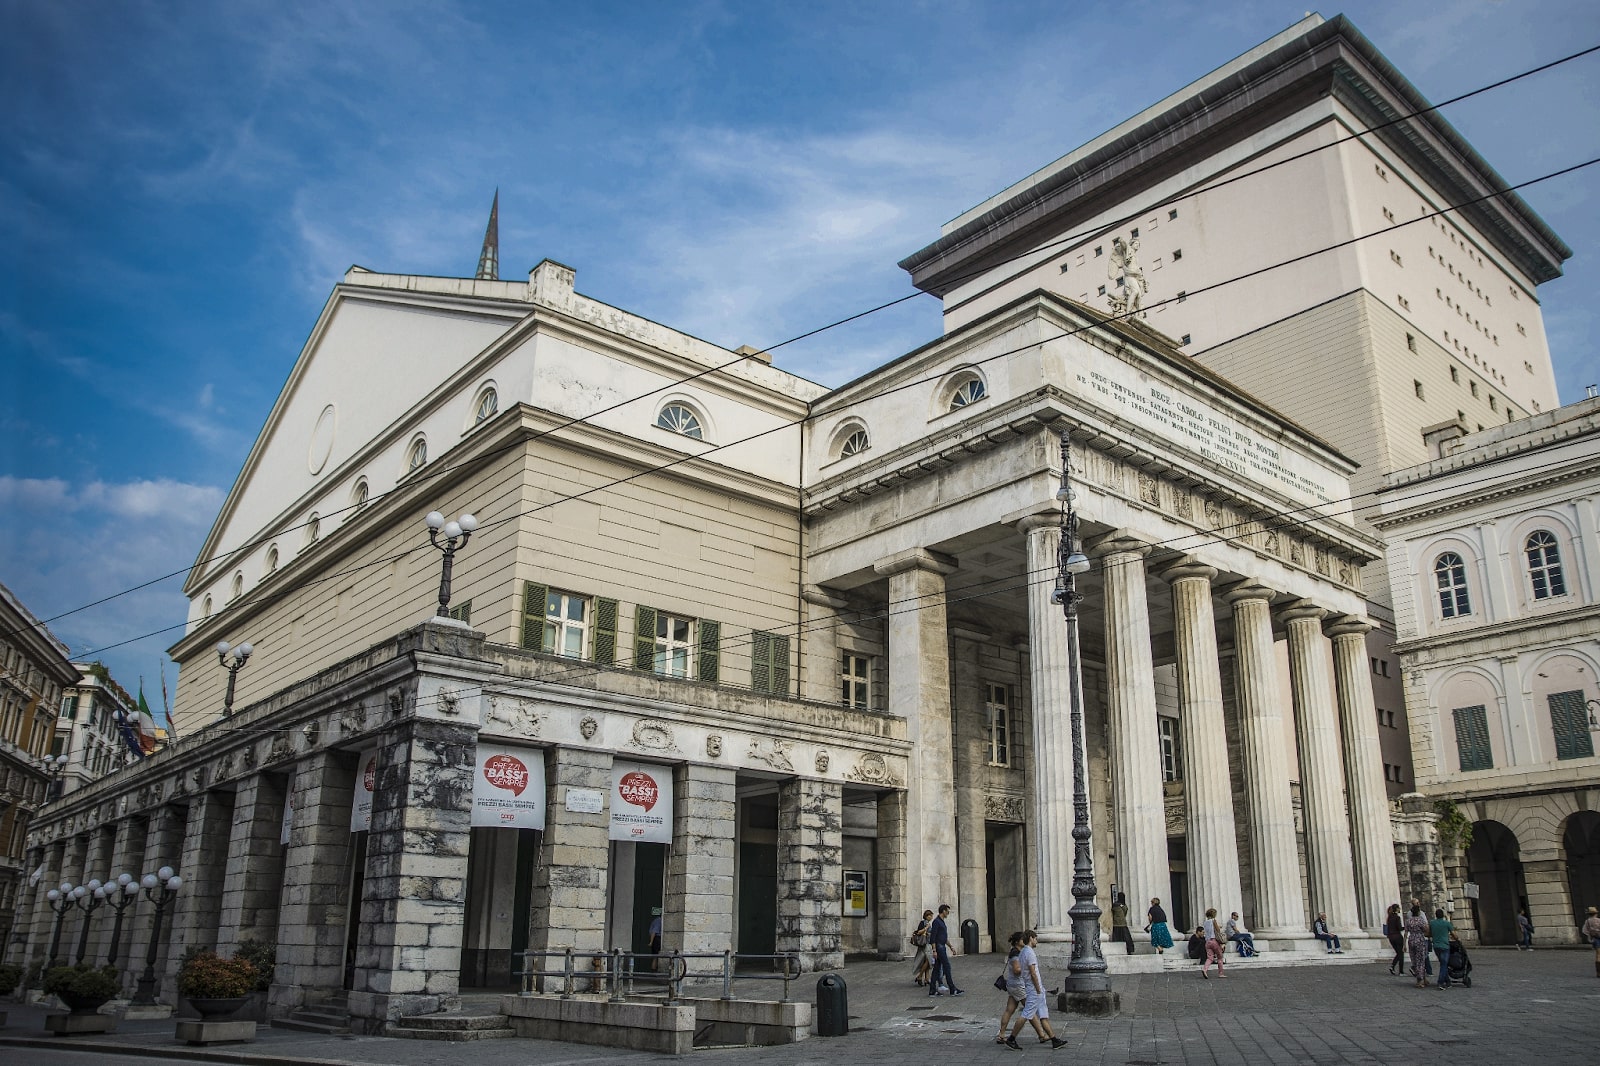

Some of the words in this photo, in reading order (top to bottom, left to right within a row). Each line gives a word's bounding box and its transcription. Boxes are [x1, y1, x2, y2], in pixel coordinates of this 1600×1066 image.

[1176, 402, 1204, 422] CAROLO
[1208, 418, 1231, 436] FELICI
[493, 762, 520, 771] PREZZI
[487, 768, 524, 780] BASSI
[493, 778, 524, 787] SEMPRE
[627, 779, 652, 787] PREZZI
[622, 785, 654, 797] BASSI
[626, 794, 654, 803] SEMPRE
